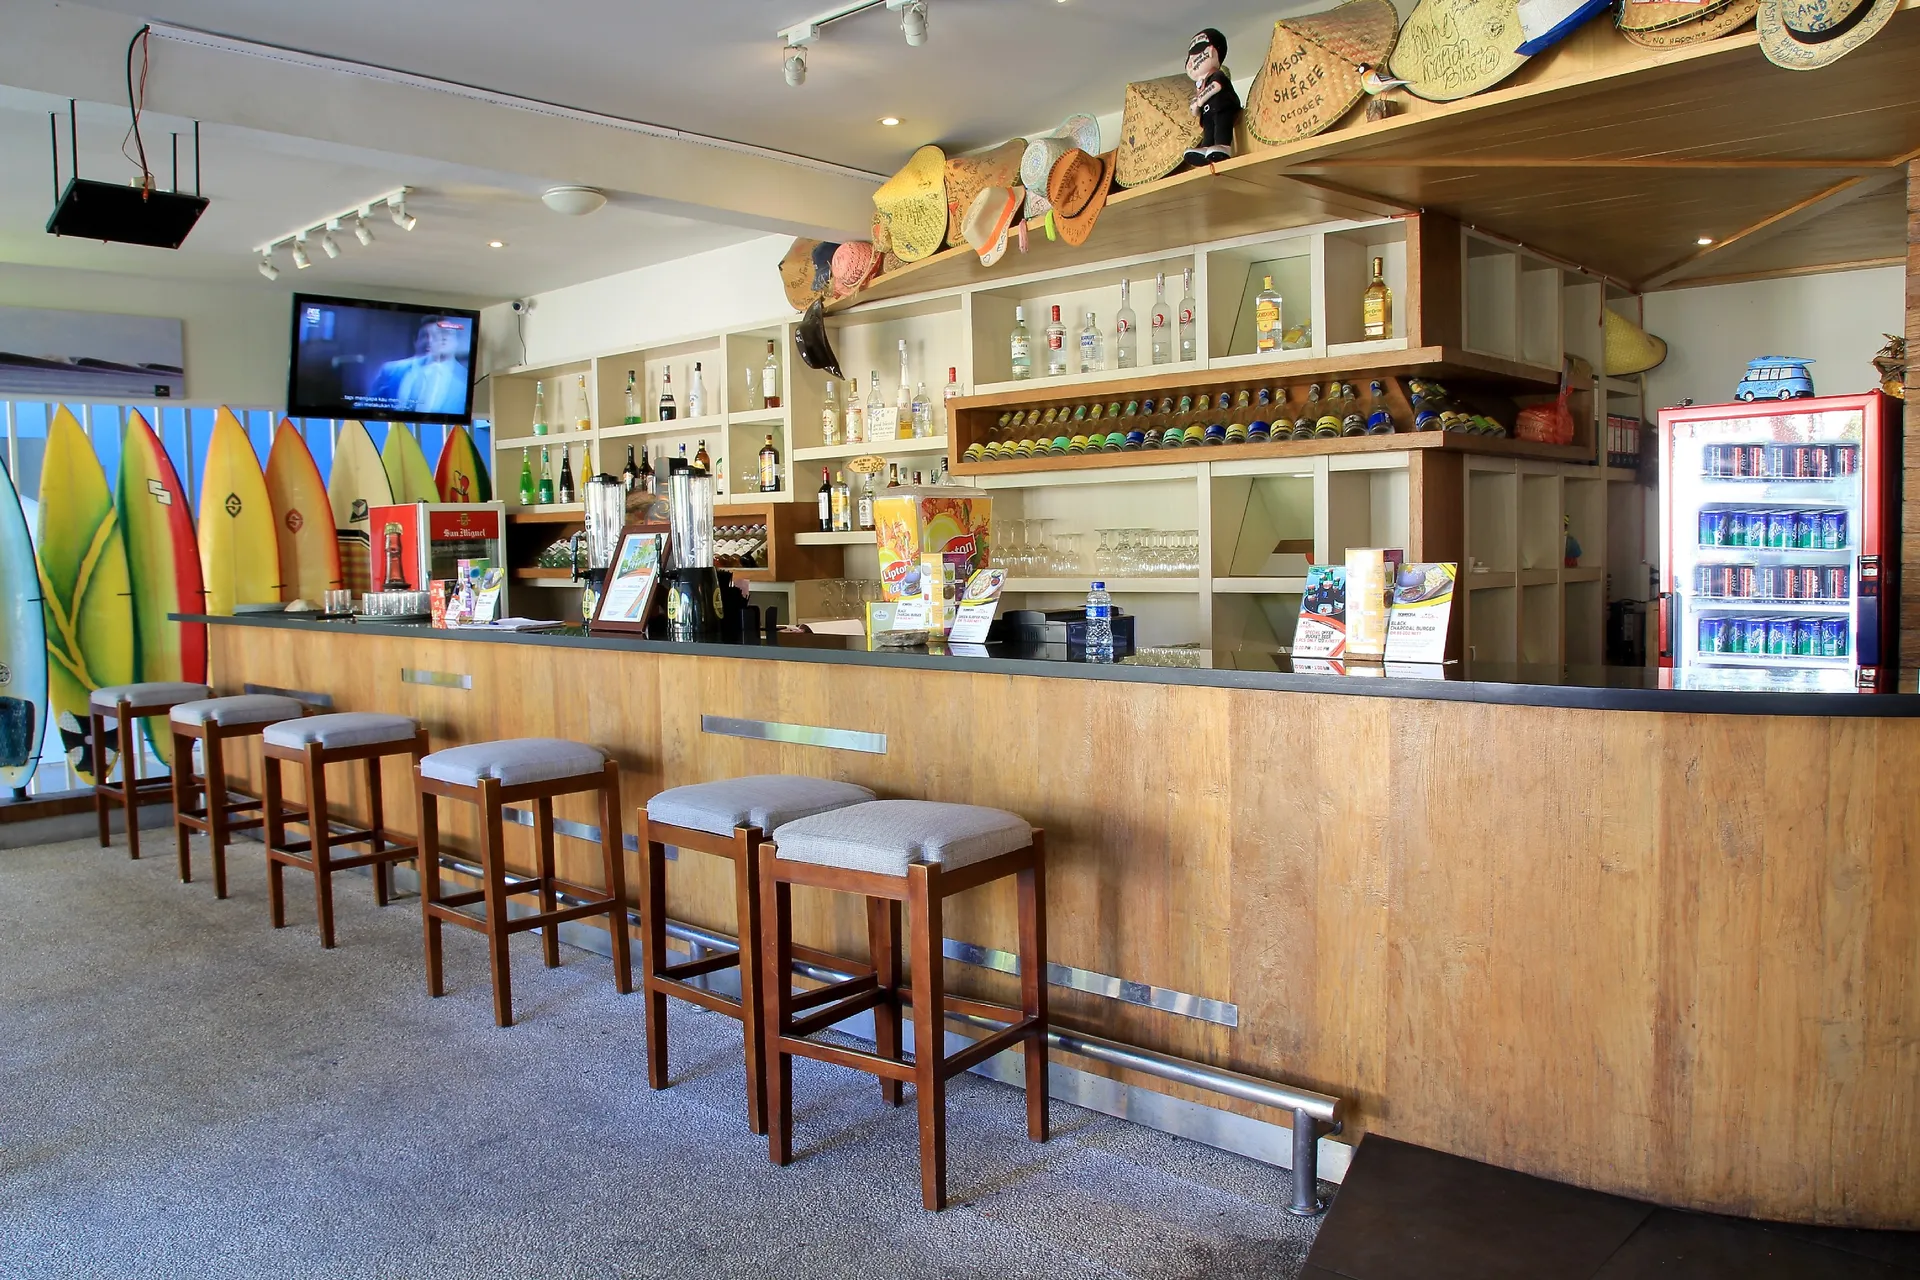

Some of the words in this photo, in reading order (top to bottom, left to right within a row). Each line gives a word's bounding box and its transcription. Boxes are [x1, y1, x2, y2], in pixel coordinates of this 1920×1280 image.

[1270, 44, 1307, 77] MASON
[1273, 64, 1324, 104] SHEREE
[1280, 94, 1324, 124] OCTOBER
[1295, 114, 1320, 133] 2012
[443, 528, 458, 537] San
[459, 527, 486, 538] Miguel
